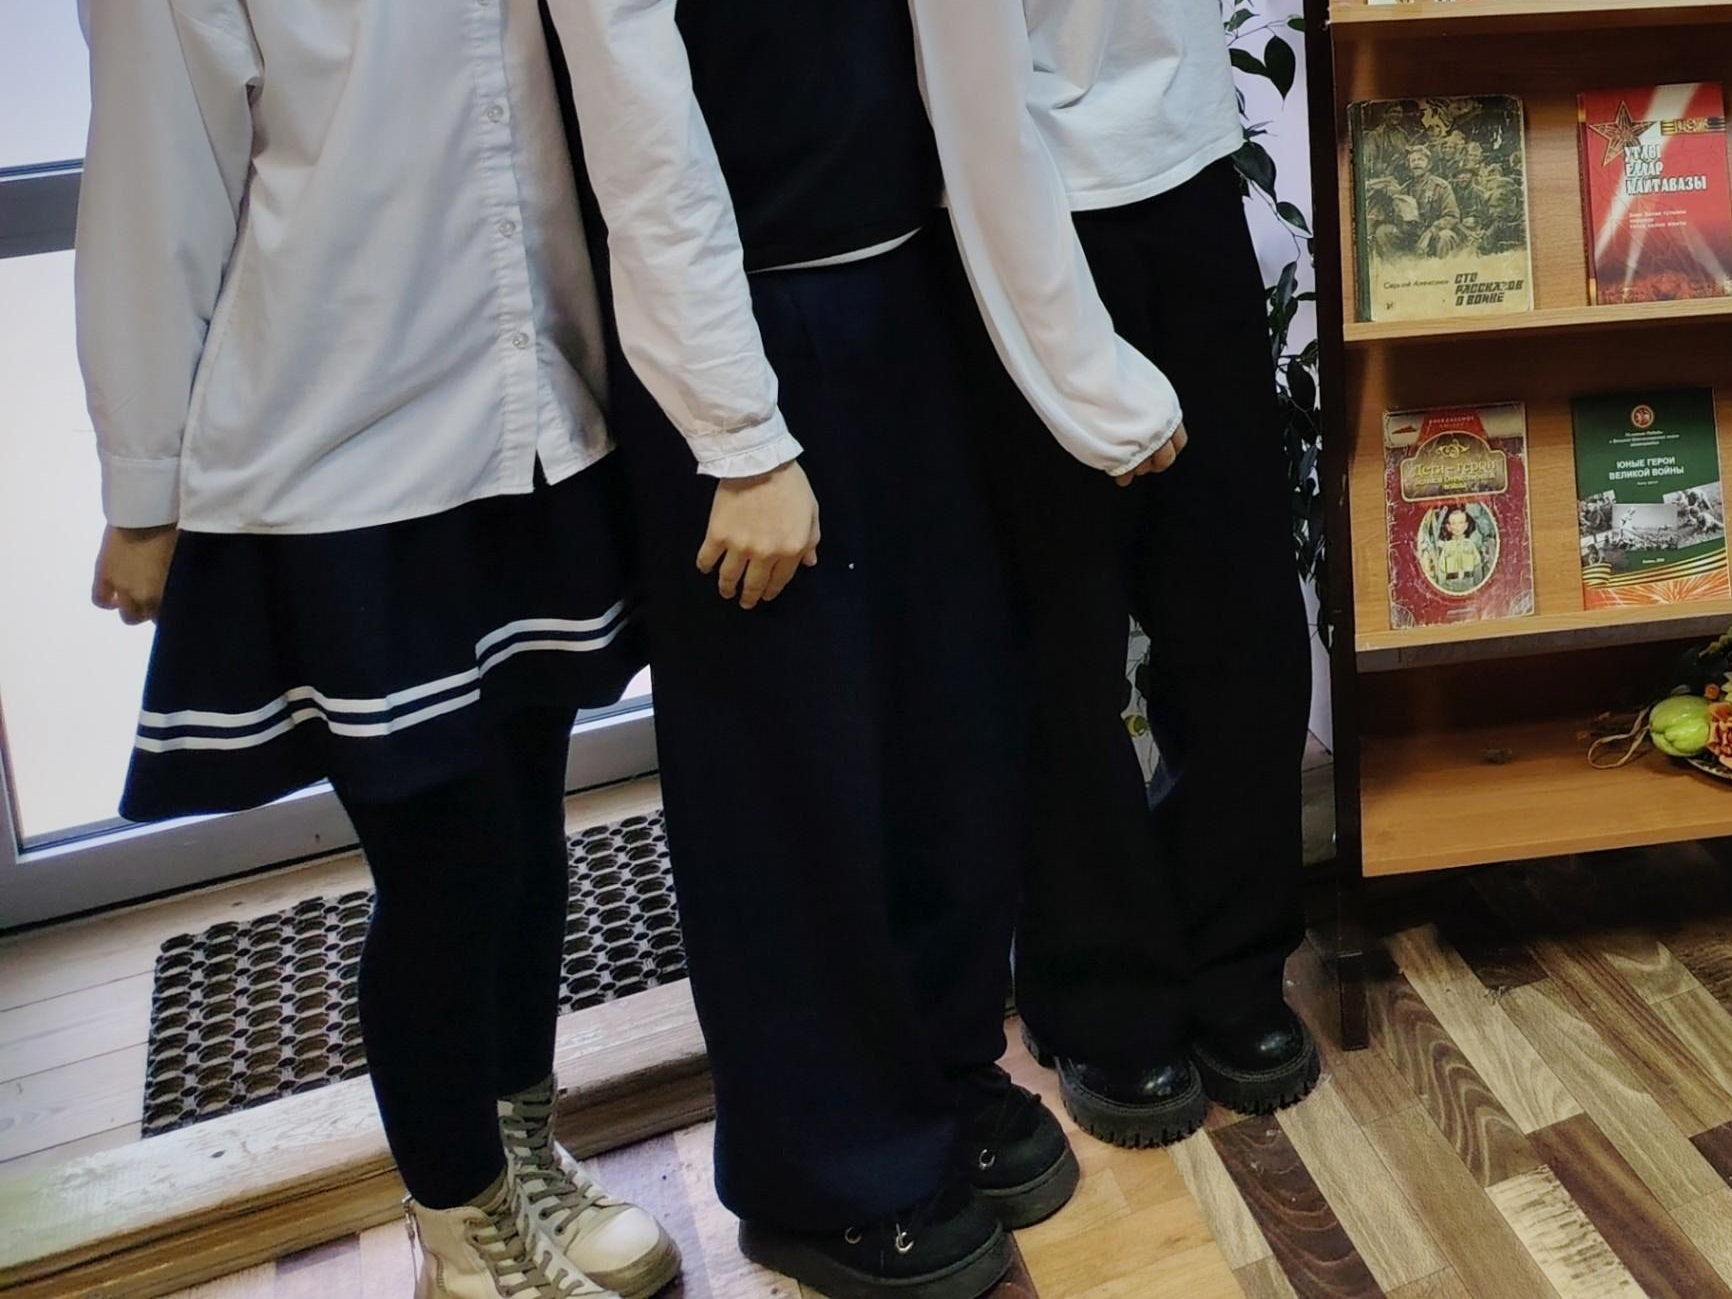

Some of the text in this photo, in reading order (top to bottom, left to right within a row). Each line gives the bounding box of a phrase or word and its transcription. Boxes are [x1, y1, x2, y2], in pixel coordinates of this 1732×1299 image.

[1624, 145, 1661, 163] УТЛЫ
[1625, 162, 1664, 178] ЕЛЛАР
[1625, 175, 1707, 195] КАЙТАВАЗЫ
[1454, 271, 1478, 285] СТО
[1455, 280, 1524, 296] РАССКАЗОВ
[1455, 292, 1504, 306] О ВОЙНЕ
[1616, 456, 1676, 469] ЮНЫЕ ГЕРОИ
[1608, 465, 1685, 481] ВЕЛИКОЙ ВОЙНЫ
